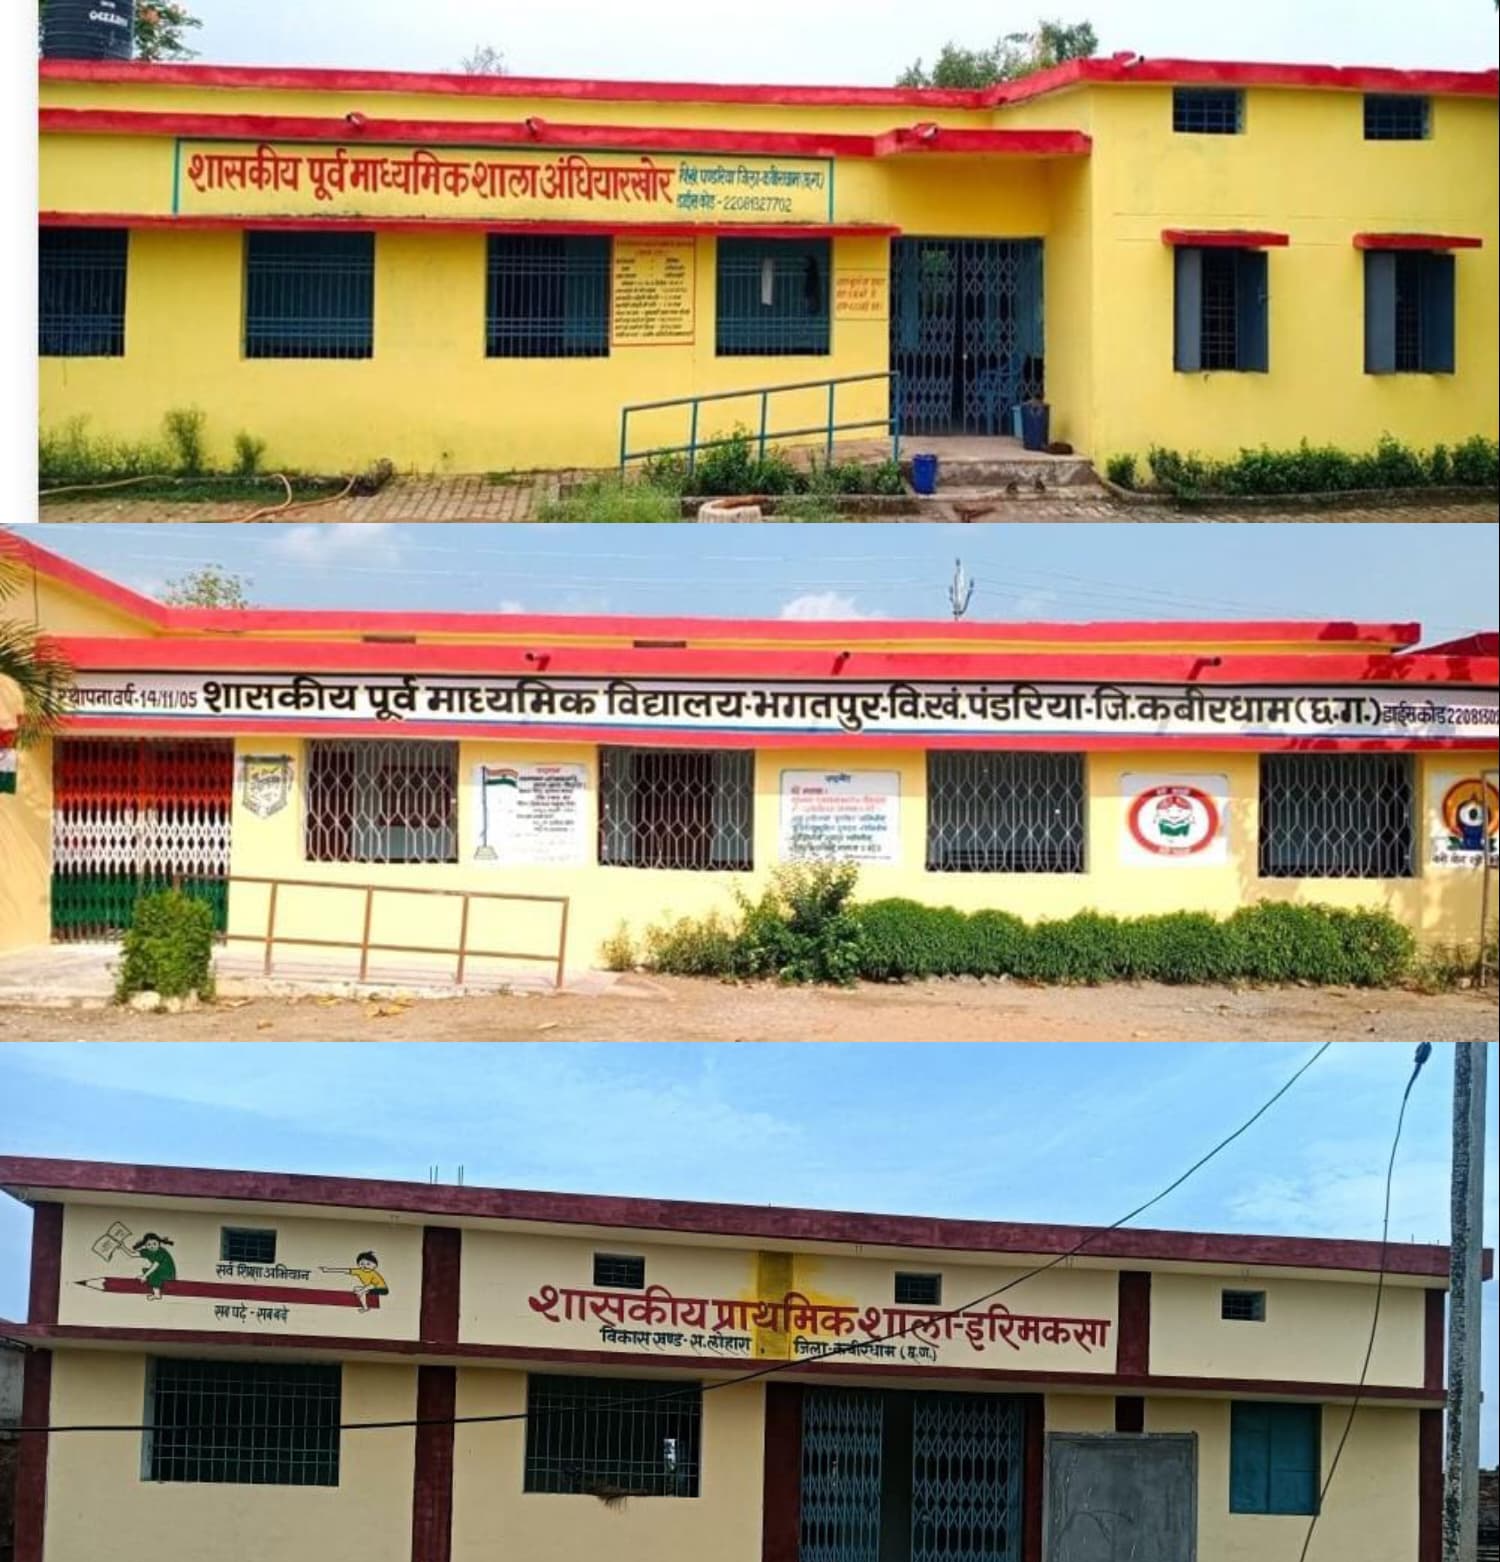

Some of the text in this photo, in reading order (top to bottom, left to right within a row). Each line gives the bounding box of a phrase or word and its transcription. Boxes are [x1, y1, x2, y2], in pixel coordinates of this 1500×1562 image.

[188, 144, 301, 192] शासकीय
[307, 147, 349, 201] पूर्व
[350, 150, 471, 196] माध्यमिक
[471, 160, 541, 200] शाला
[202, 676, 358, 713] शासकीय
[364, 676, 419, 721] पूर्व
[424, 678, 599, 716] माध्यमिक
[529, 1284, 709, 1329] शासकीय
[711, 1291, 859, 1336] प्राथमिक
